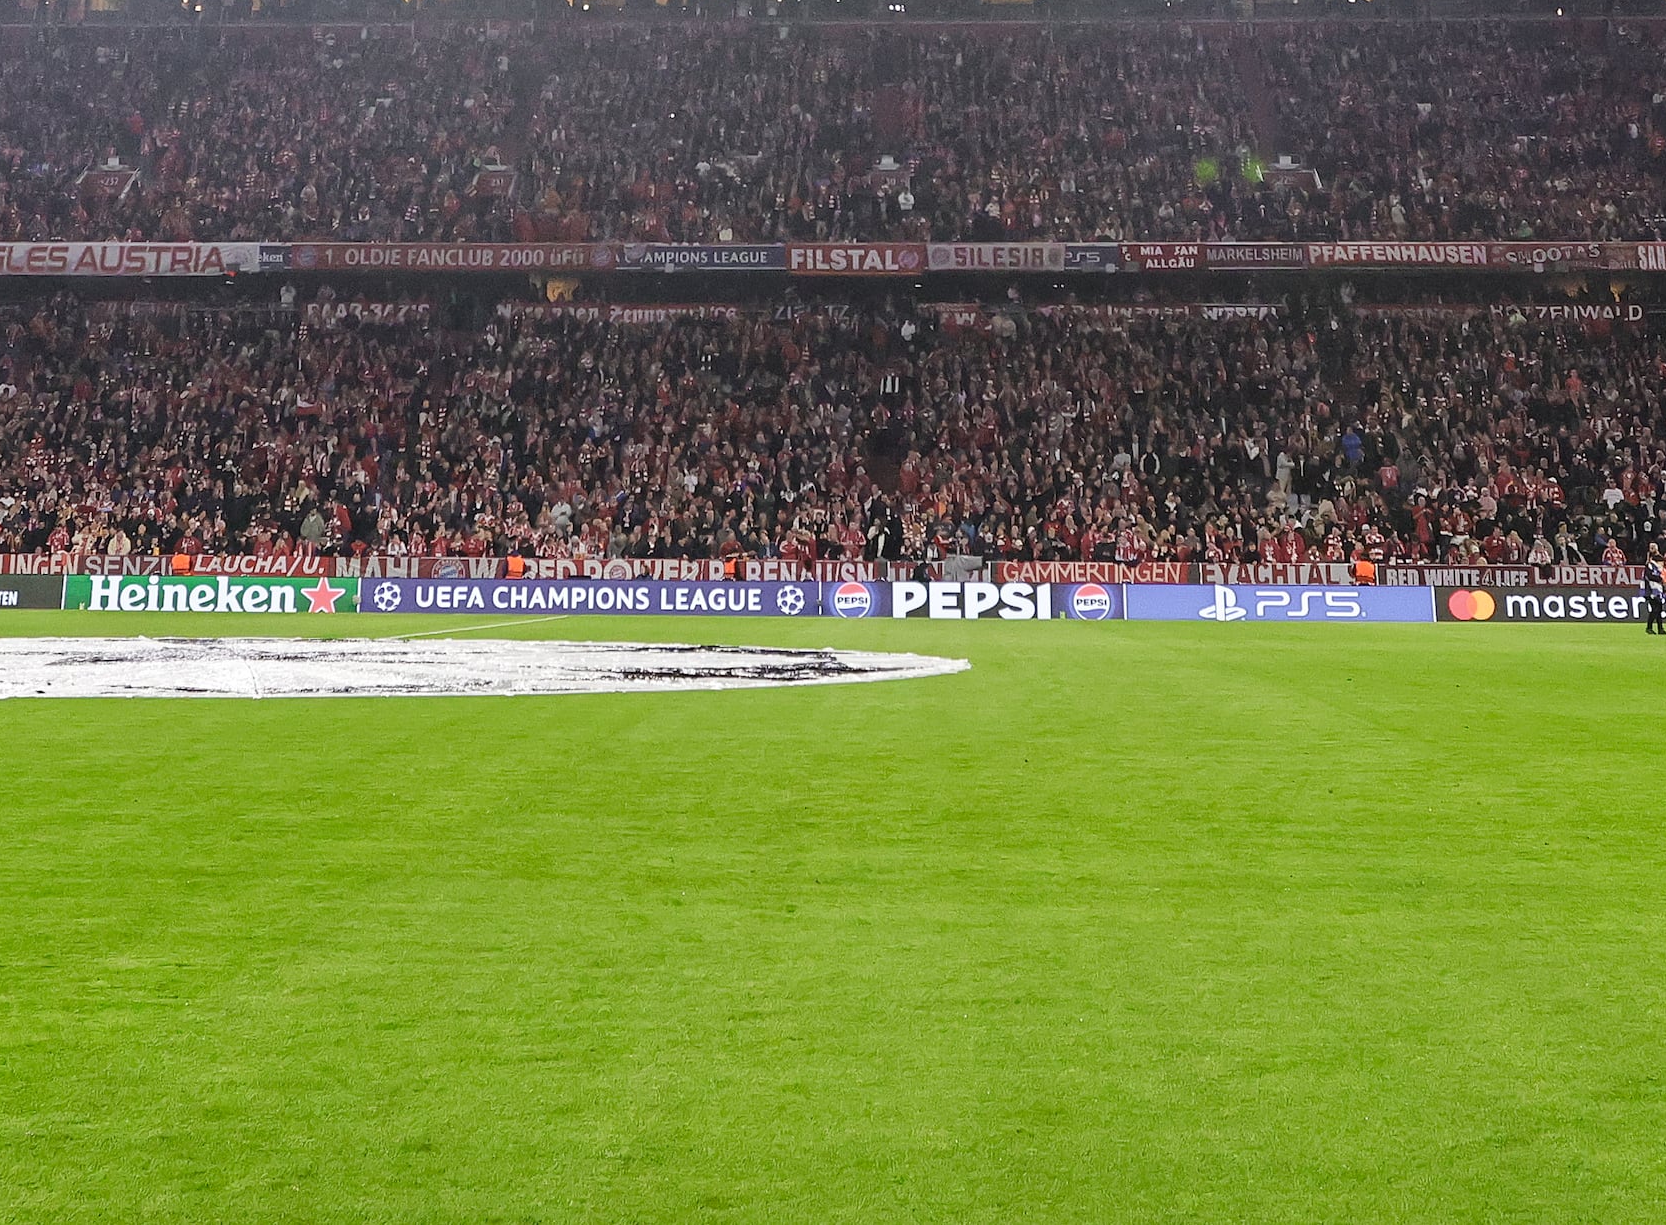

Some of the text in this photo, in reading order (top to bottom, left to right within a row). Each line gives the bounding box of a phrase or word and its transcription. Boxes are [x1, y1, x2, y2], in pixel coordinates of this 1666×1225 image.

[73, 246, 224, 273] AUSTRIA
[345, 248, 401, 266] OLDIE
[406, 248, 493, 267] FANCLUB
[500, 248, 544, 267] 2000
[712, 250, 768, 265] LEAGUE
[791, 248, 900, 271] FILSTAL
[1139, 245, 1163, 256] MIA
[1206, 248, 1303, 262] MARKELSHEIM
[1308, 244, 1487, 265] PFAFFENHAUSEN
[1145, 255, 1195, 269] ALLGÄU
[194, 555, 325, 577] LAUCHA/U.
[1003, 561, 1181, 583] GAMMERTINGEN
[1201, 563, 1343, 585] EYACHTAL
[1386, 568, 1420, 586] RED
[1424, 568, 1480, 586] WHITE
[87, 575, 297, 612] Heineken
[416, 586, 762, 612] UEFA CHAMPIONS LEAGUE
[836, 596, 869, 606] PEPSI
[892, 582, 1051, 620] PEPSI
[1076, 597, 1108, 607] PEPSI
[1255, 591, 1360, 617] PS5
